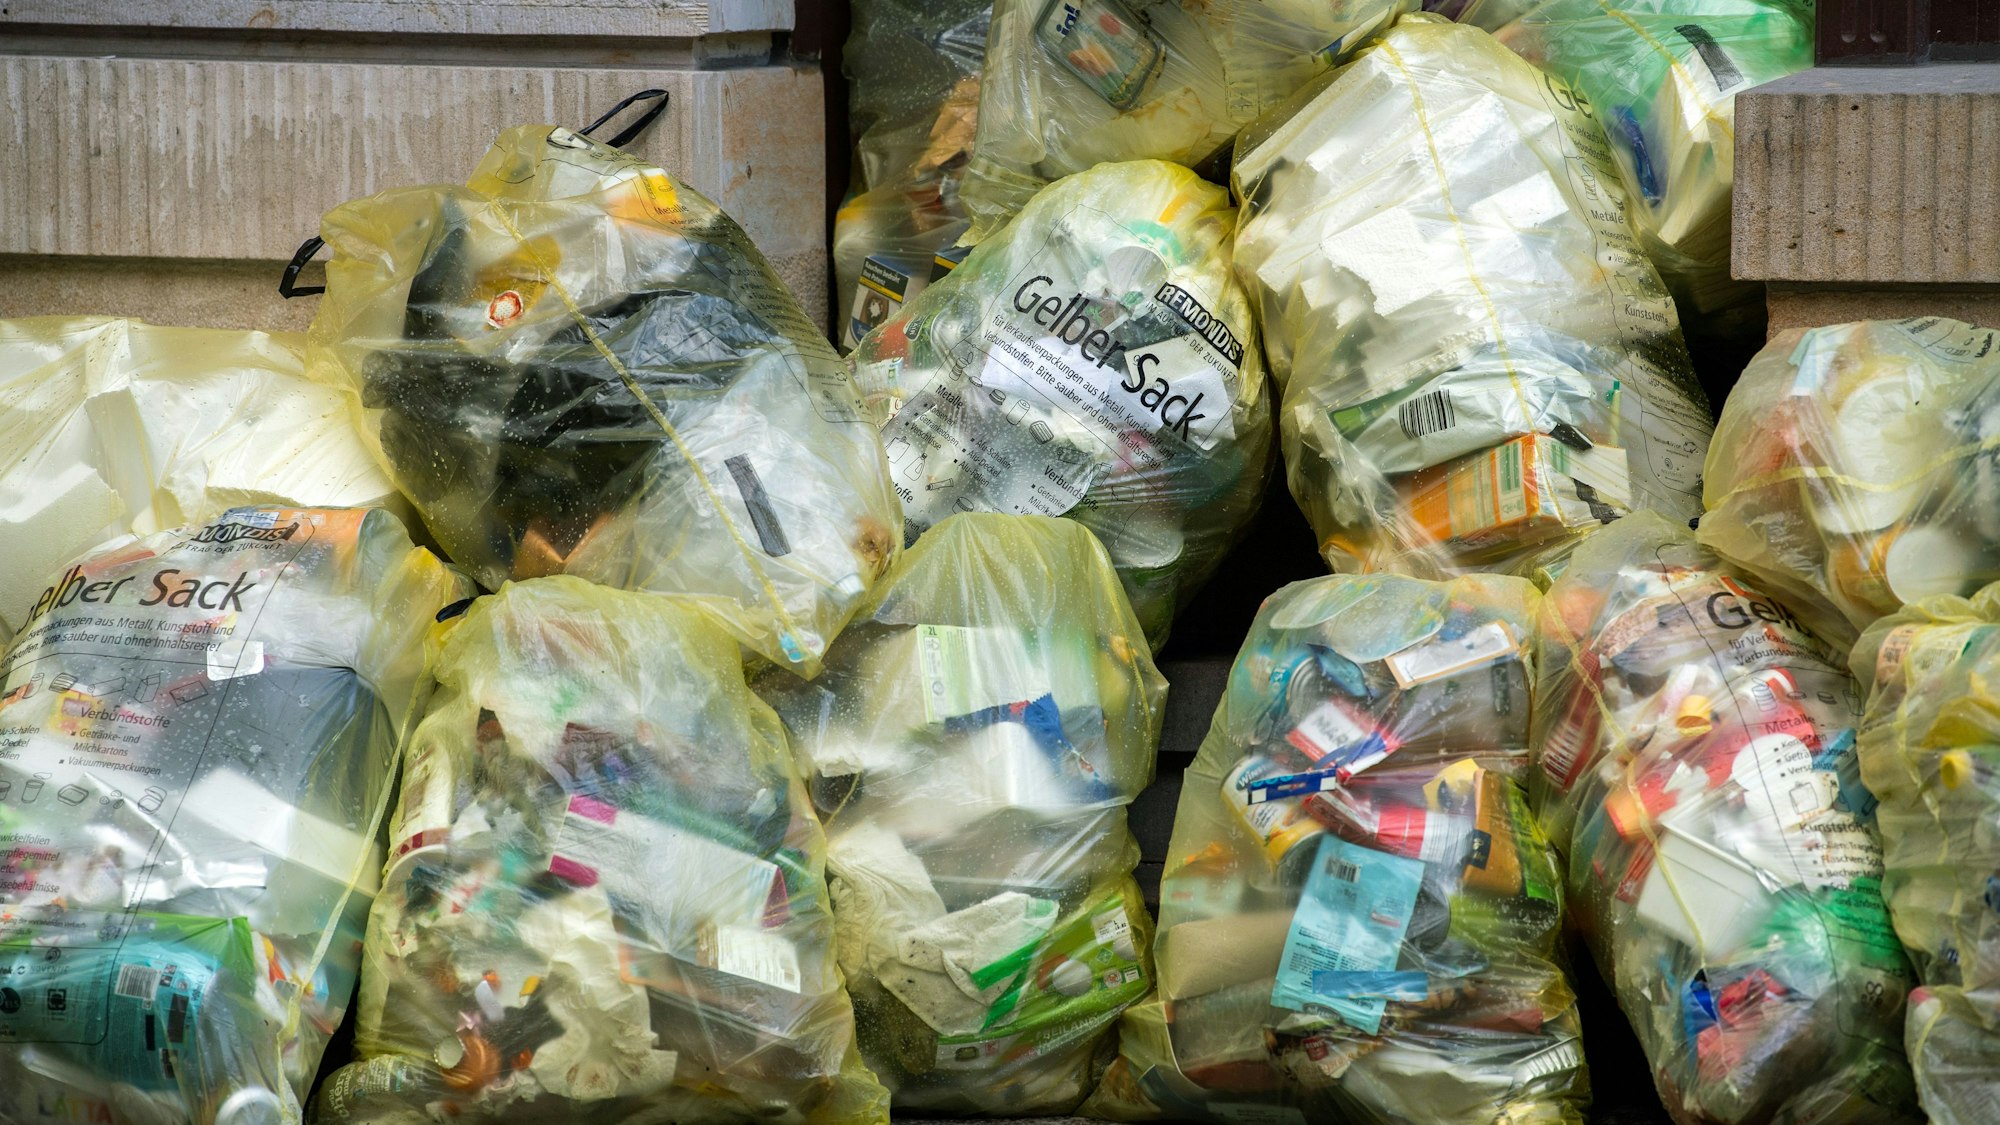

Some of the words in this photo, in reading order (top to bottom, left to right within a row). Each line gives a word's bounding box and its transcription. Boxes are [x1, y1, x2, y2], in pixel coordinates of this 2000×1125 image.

[1591, 209, 1624, 224] Metalle
[1155, 283, 1243, 366] REMONDIS
[1146, 302, 1156, 314] IM
[1157, 311, 1190, 342] AUFTRAG
[1189, 338, 1205, 355] DER
[1203, 352, 1237, 382] ZUKUNFT
[1013, 274, 1126, 370] Gelber
[1120, 353, 1206, 442] Sack
[935, 383, 964, 410] Metalle
[992, 314, 1003, 326] für
[1002, 320, 1084, 387] Verkaufsverpackungen
[1082, 381, 1099, 397] aus
[1098, 391, 1124, 419] Metall,
[1125, 412, 1162, 448] Kunststoff
[1159, 444, 1176, 461] und
[1035, 365, 1056, 386] Bitte
[1054, 380, 1083, 406] sauber
[1081, 399, 1100, 418] und
[1097, 413, 1118, 435] ohne
[1116, 429, 1162, 470] Inhaltsreste!
[909, 421, 942, 451] Verschlüsse
[966, 449, 1002, 479] Alu-Deckel
[976, 439, 1012, 470] Alu-Schalen
[957, 460, 991, 488] Alu-Folien
[1036, 484, 1067, 511] Getränke-
[1043, 464, 1100, 514] Verbundstoffe
[214, 544, 235, 554] DER
[236, 541, 283, 552] ZUKUNFT
[139, 568, 258, 613] Sack
[95, 616, 115, 628] aus
[117, 617, 154, 632] Metall,
[157, 620, 213, 636] Kunststoff
[212, 624, 237, 637] und
[62, 631, 99, 644] sauber
[100, 633, 122, 646] und
[124, 635, 152, 648] ohne
[152, 636, 222, 653] Inhaltsreste!
[80, 706, 171, 729] Verbundstoffe
[1764, 716, 1816, 736] Metalle
[73, 741, 129, 758] Milchkartons
[79, 728, 122, 743] Getränke-
[122, 734, 143, 745] und
[67, 756, 162, 776] Vakuumverpackungen
[0, 864, 16, 875] etc.
